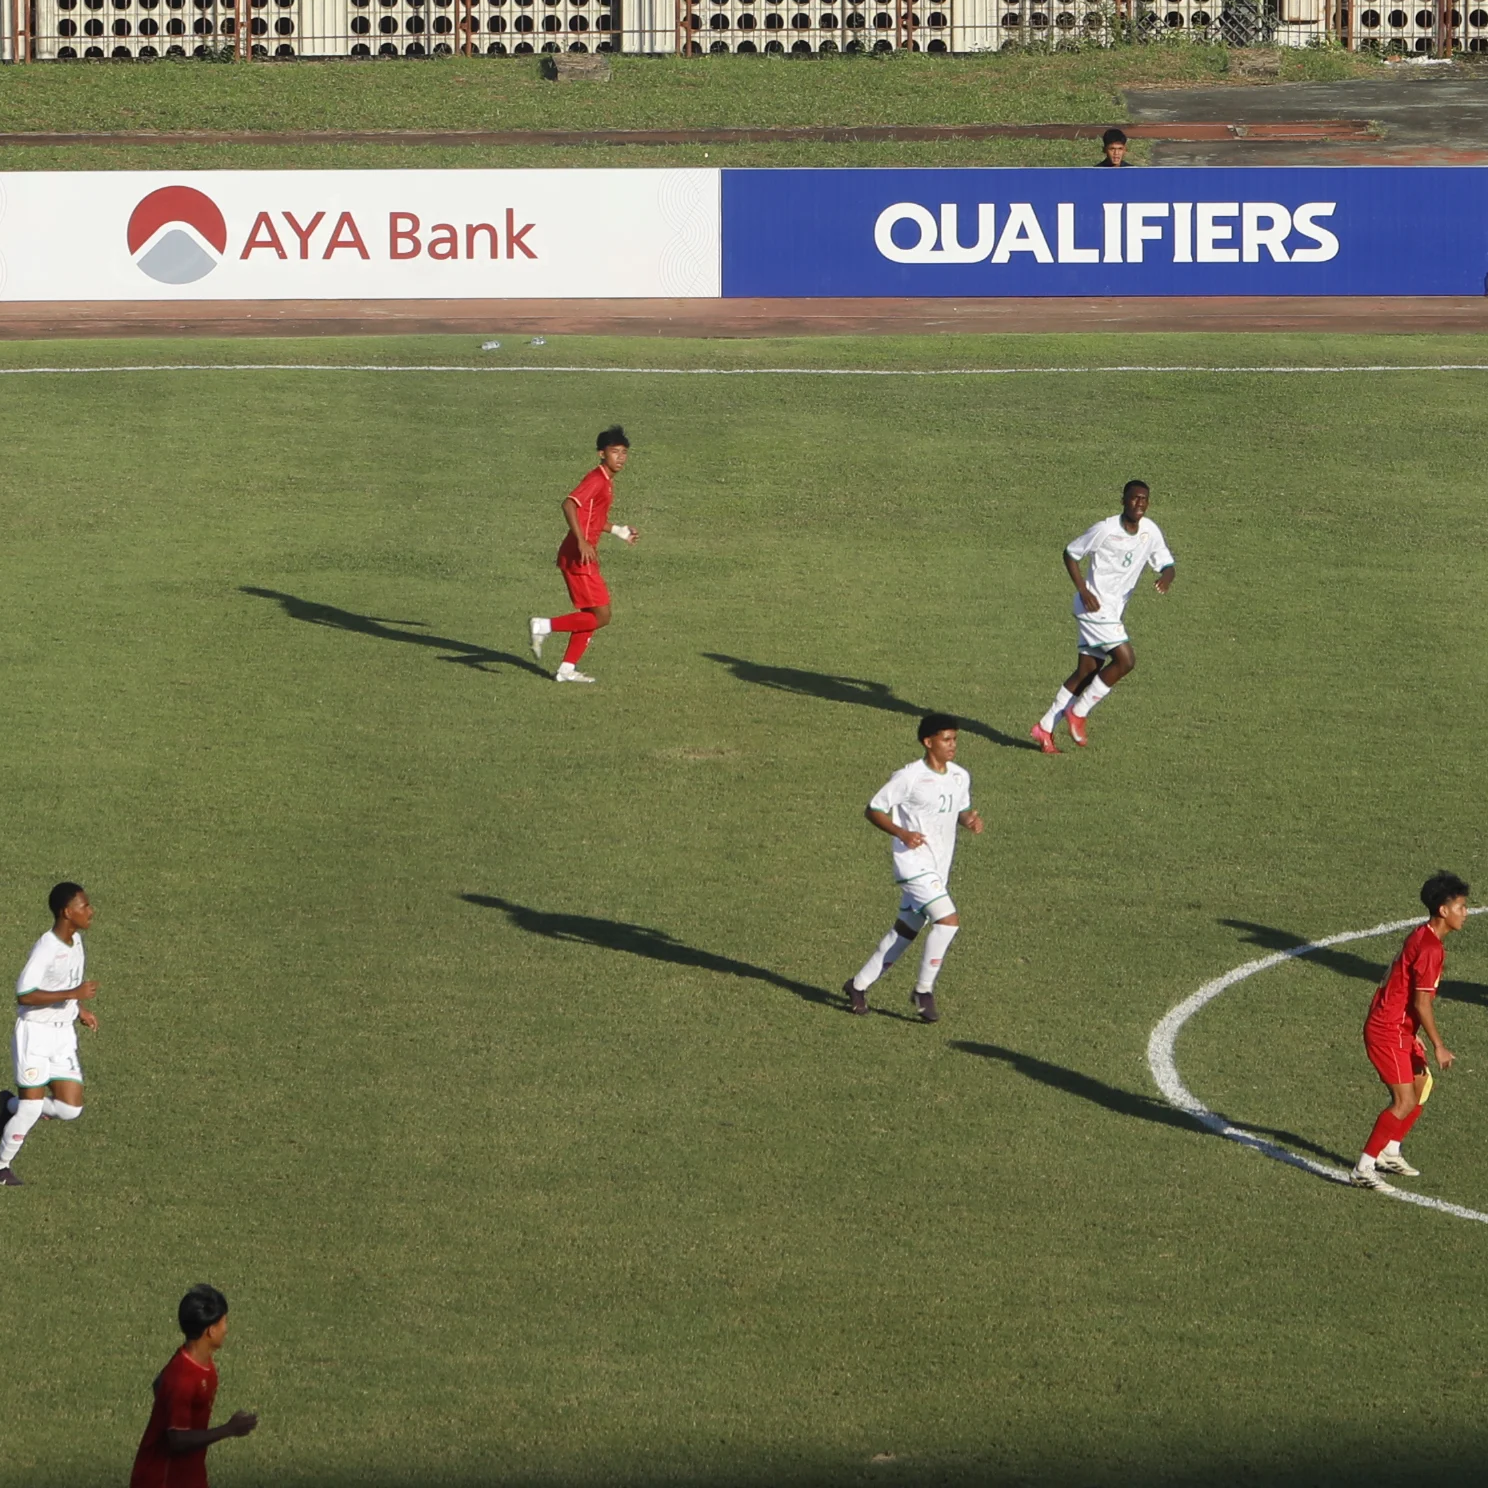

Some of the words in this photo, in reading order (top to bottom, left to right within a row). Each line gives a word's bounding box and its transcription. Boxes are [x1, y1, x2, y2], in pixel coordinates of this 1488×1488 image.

[241, 212, 369, 259] AYA
[391, 209, 537, 260] Bank
[874, 202, 1339, 264] QUALIFIERS
[1121, 552, 1133, 568] 8
[938, 794, 954, 814] 21
